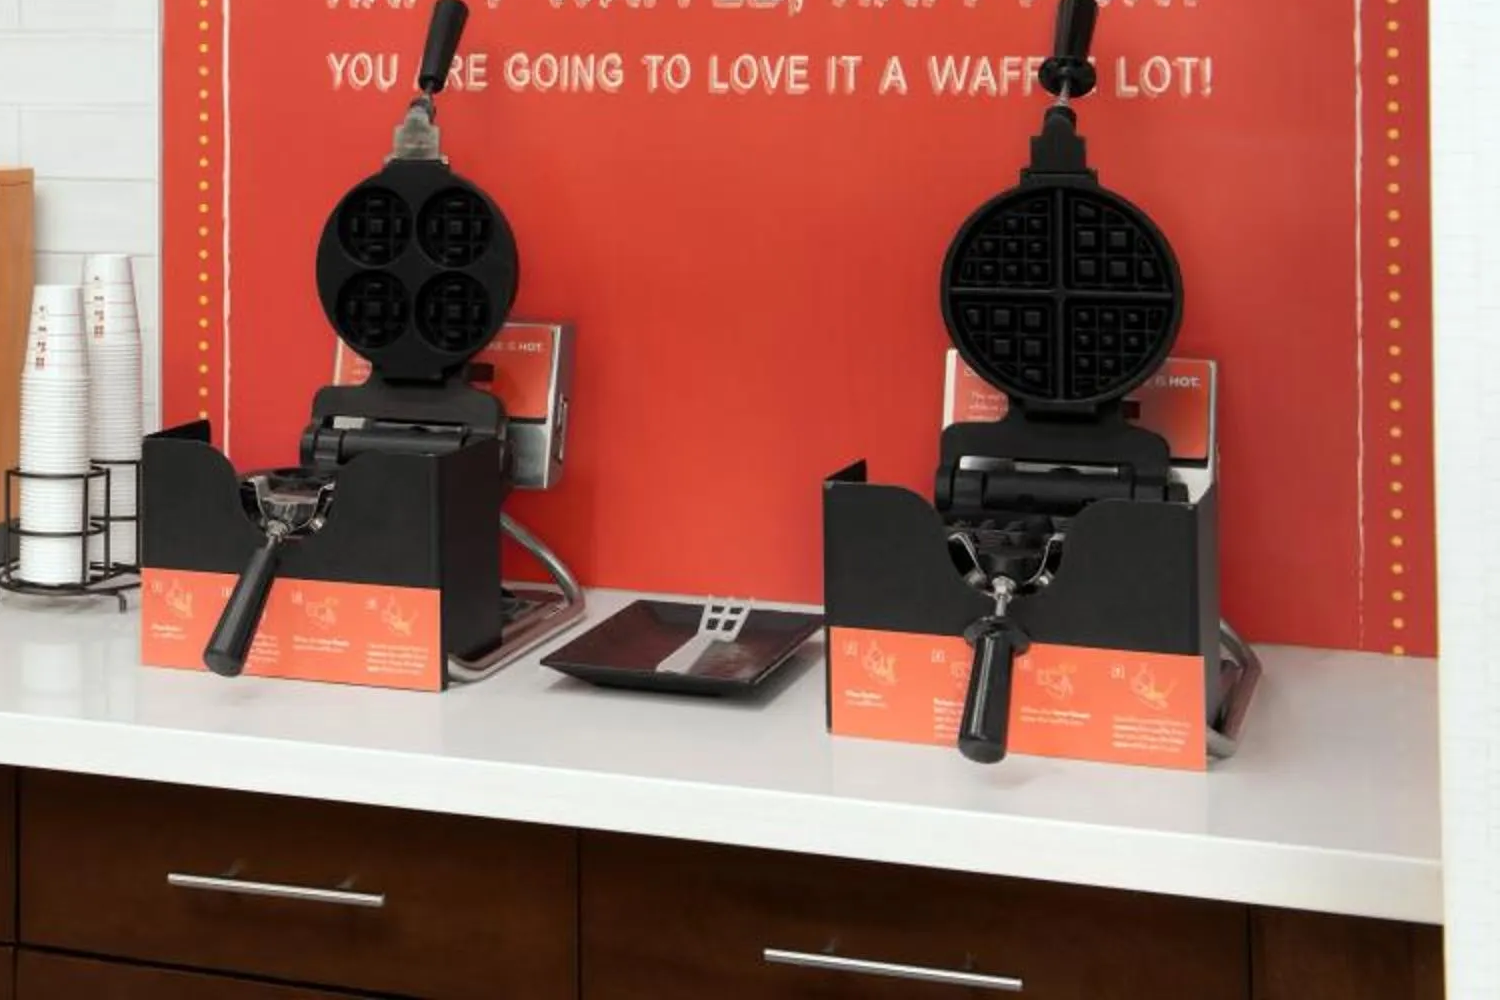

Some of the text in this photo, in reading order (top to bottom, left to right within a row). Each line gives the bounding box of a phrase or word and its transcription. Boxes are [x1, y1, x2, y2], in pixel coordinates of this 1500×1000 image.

[326, 52, 1213, 98] YOU RE GOING TO LOVE IT A WAFF LOT!
